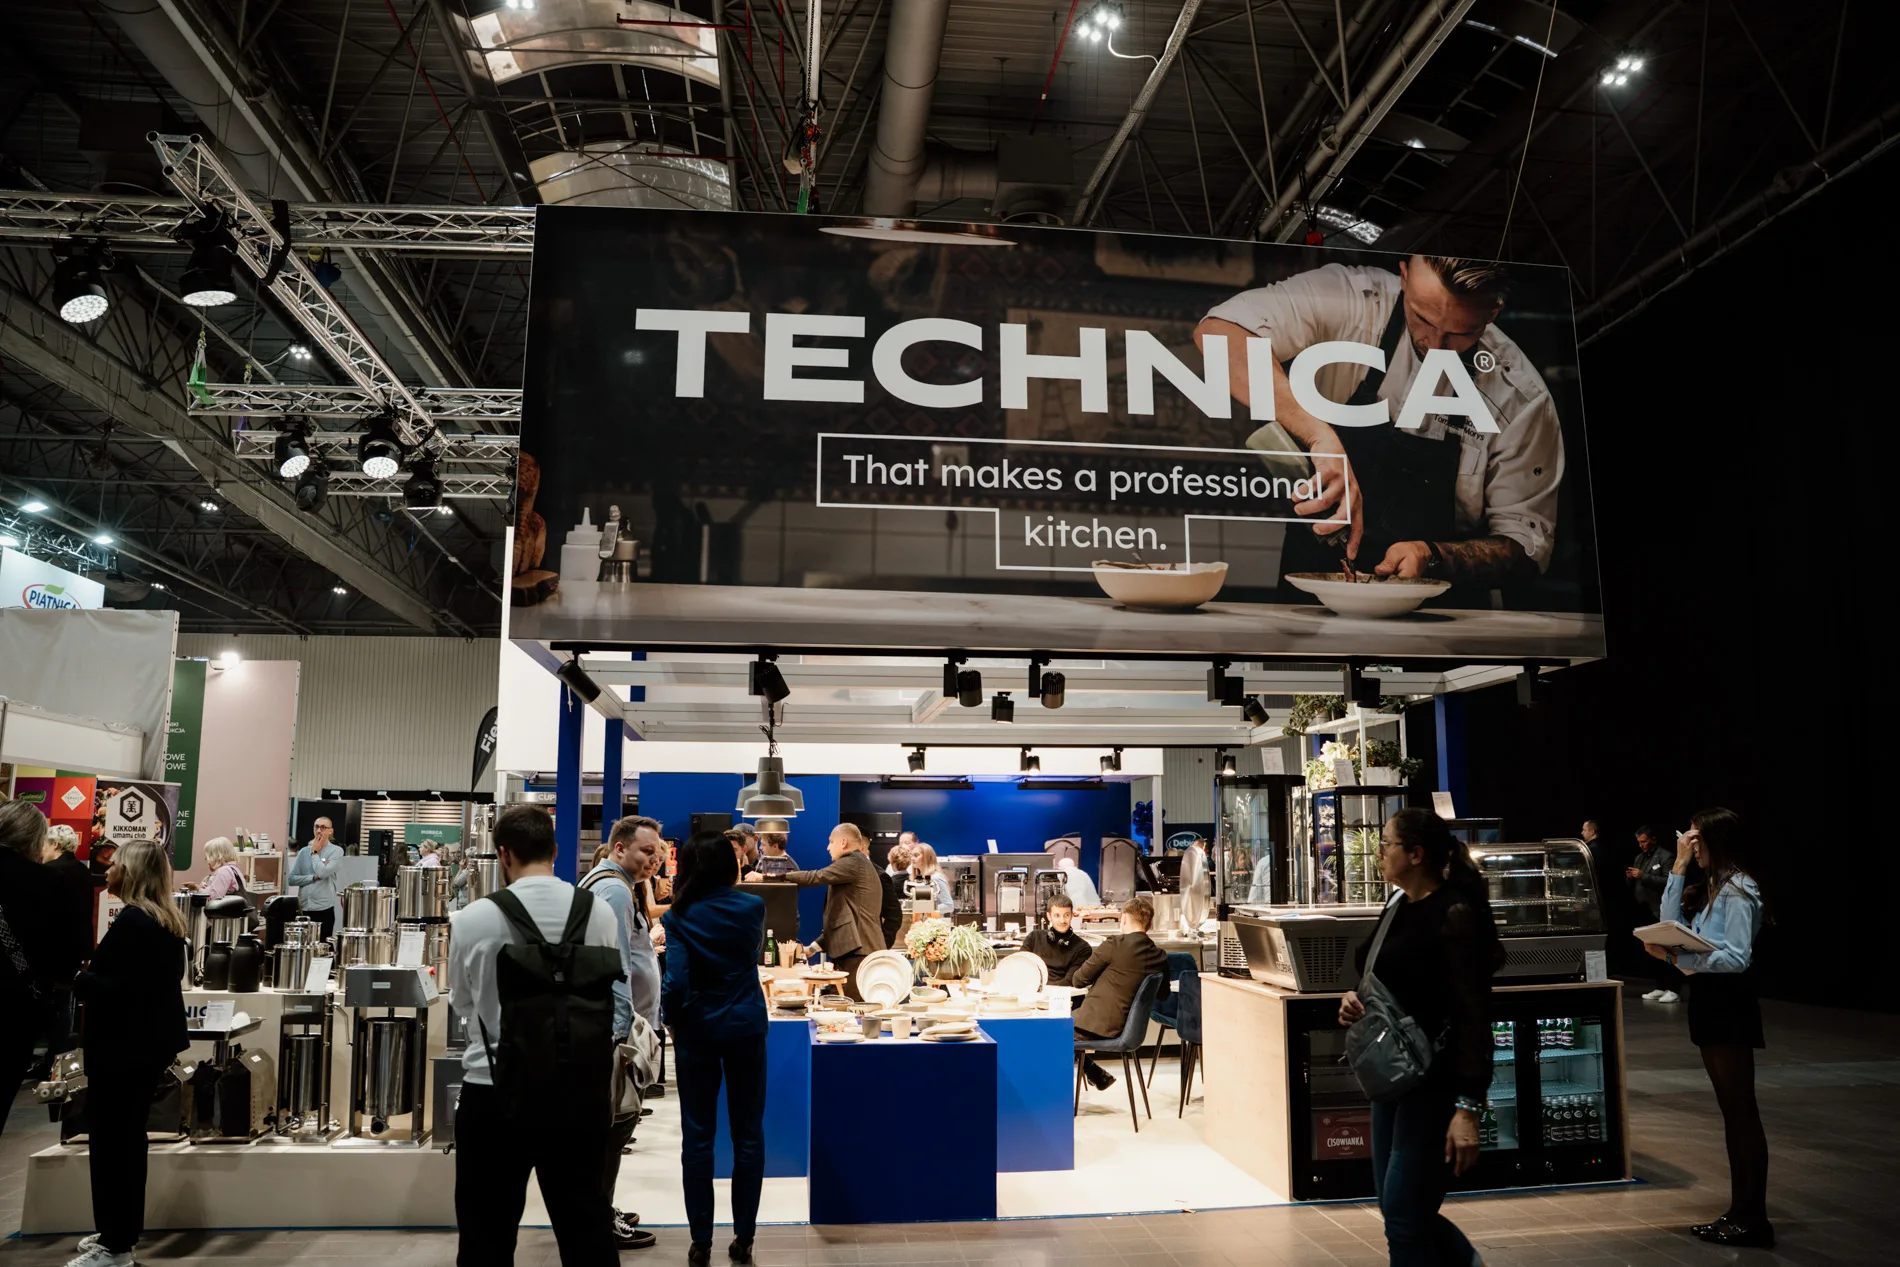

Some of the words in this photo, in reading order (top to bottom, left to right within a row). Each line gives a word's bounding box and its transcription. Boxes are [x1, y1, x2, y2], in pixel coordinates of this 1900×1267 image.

[843, 454, 929, 486] That
[941, 459, 1063, 491] makes
[1074, 469, 1097, 492] a
[1110, 466, 1323, 500] professional
[1024, 515, 1167, 551] kitchen.
[112, 825, 147, 833] KIKKOMAN
[1327, 1136, 1364, 1148] CISOWIANKA
